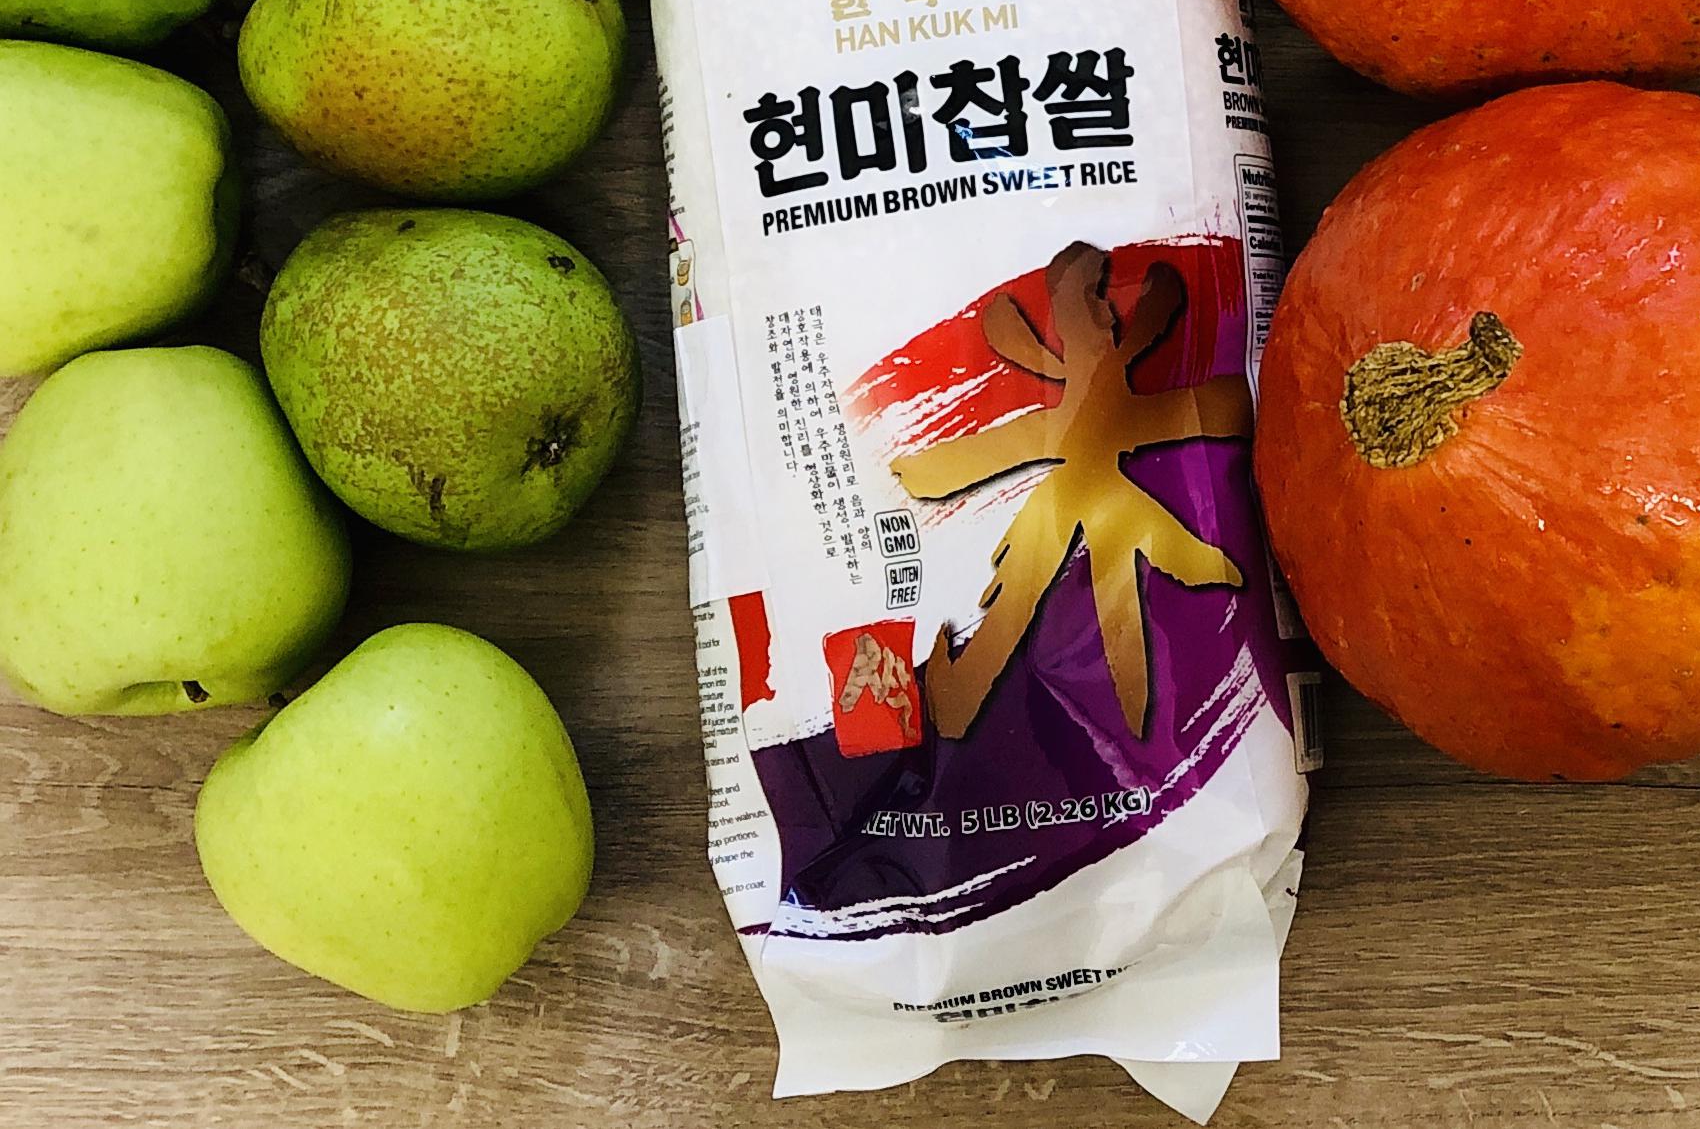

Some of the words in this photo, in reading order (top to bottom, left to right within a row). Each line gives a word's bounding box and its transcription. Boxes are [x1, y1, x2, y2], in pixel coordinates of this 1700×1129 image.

[835, 18, 901, 53] HAN
[910, 9, 976, 42] KUK
[983, 4, 1018, 32] MI
[743, 47, 1134, 198] 현미찹쌀
[763, 193, 878, 236] PREMIUM
[884, 175, 976, 214] BROWN
[982, 165, 1074, 196] SWEET
[1081, 161, 1137, 187] RICE
[779, 311, 796, 363] 대자연의
[809, 305, 826, 345] 태극은
[818, 352, 841, 415] 우주자연의
[805, 381, 823, 419] 의하여
[880, 515, 911, 534] NON
[884, 533, 916, 553] GMO
[890, 566, 919, 585] GLUTEN
[891, 587, 917, 605] FREE
[725, 783, 741, 793] and
[719, 816, 734, 827] the
[902, 812, 951, 837] WT.
[961, 810, 979, 834] 5
[984, 804, 1021, 831] LB
[1025, 796, 1098, 829] (2.26
[1102, 786, 1151, 818] KG)
[714, 853, 739, 865] shape
[740, 850, 755, 859] the
[980, 980, 1042, 1003] BROWN
[1046, 968, 1101, 991] SWEET
